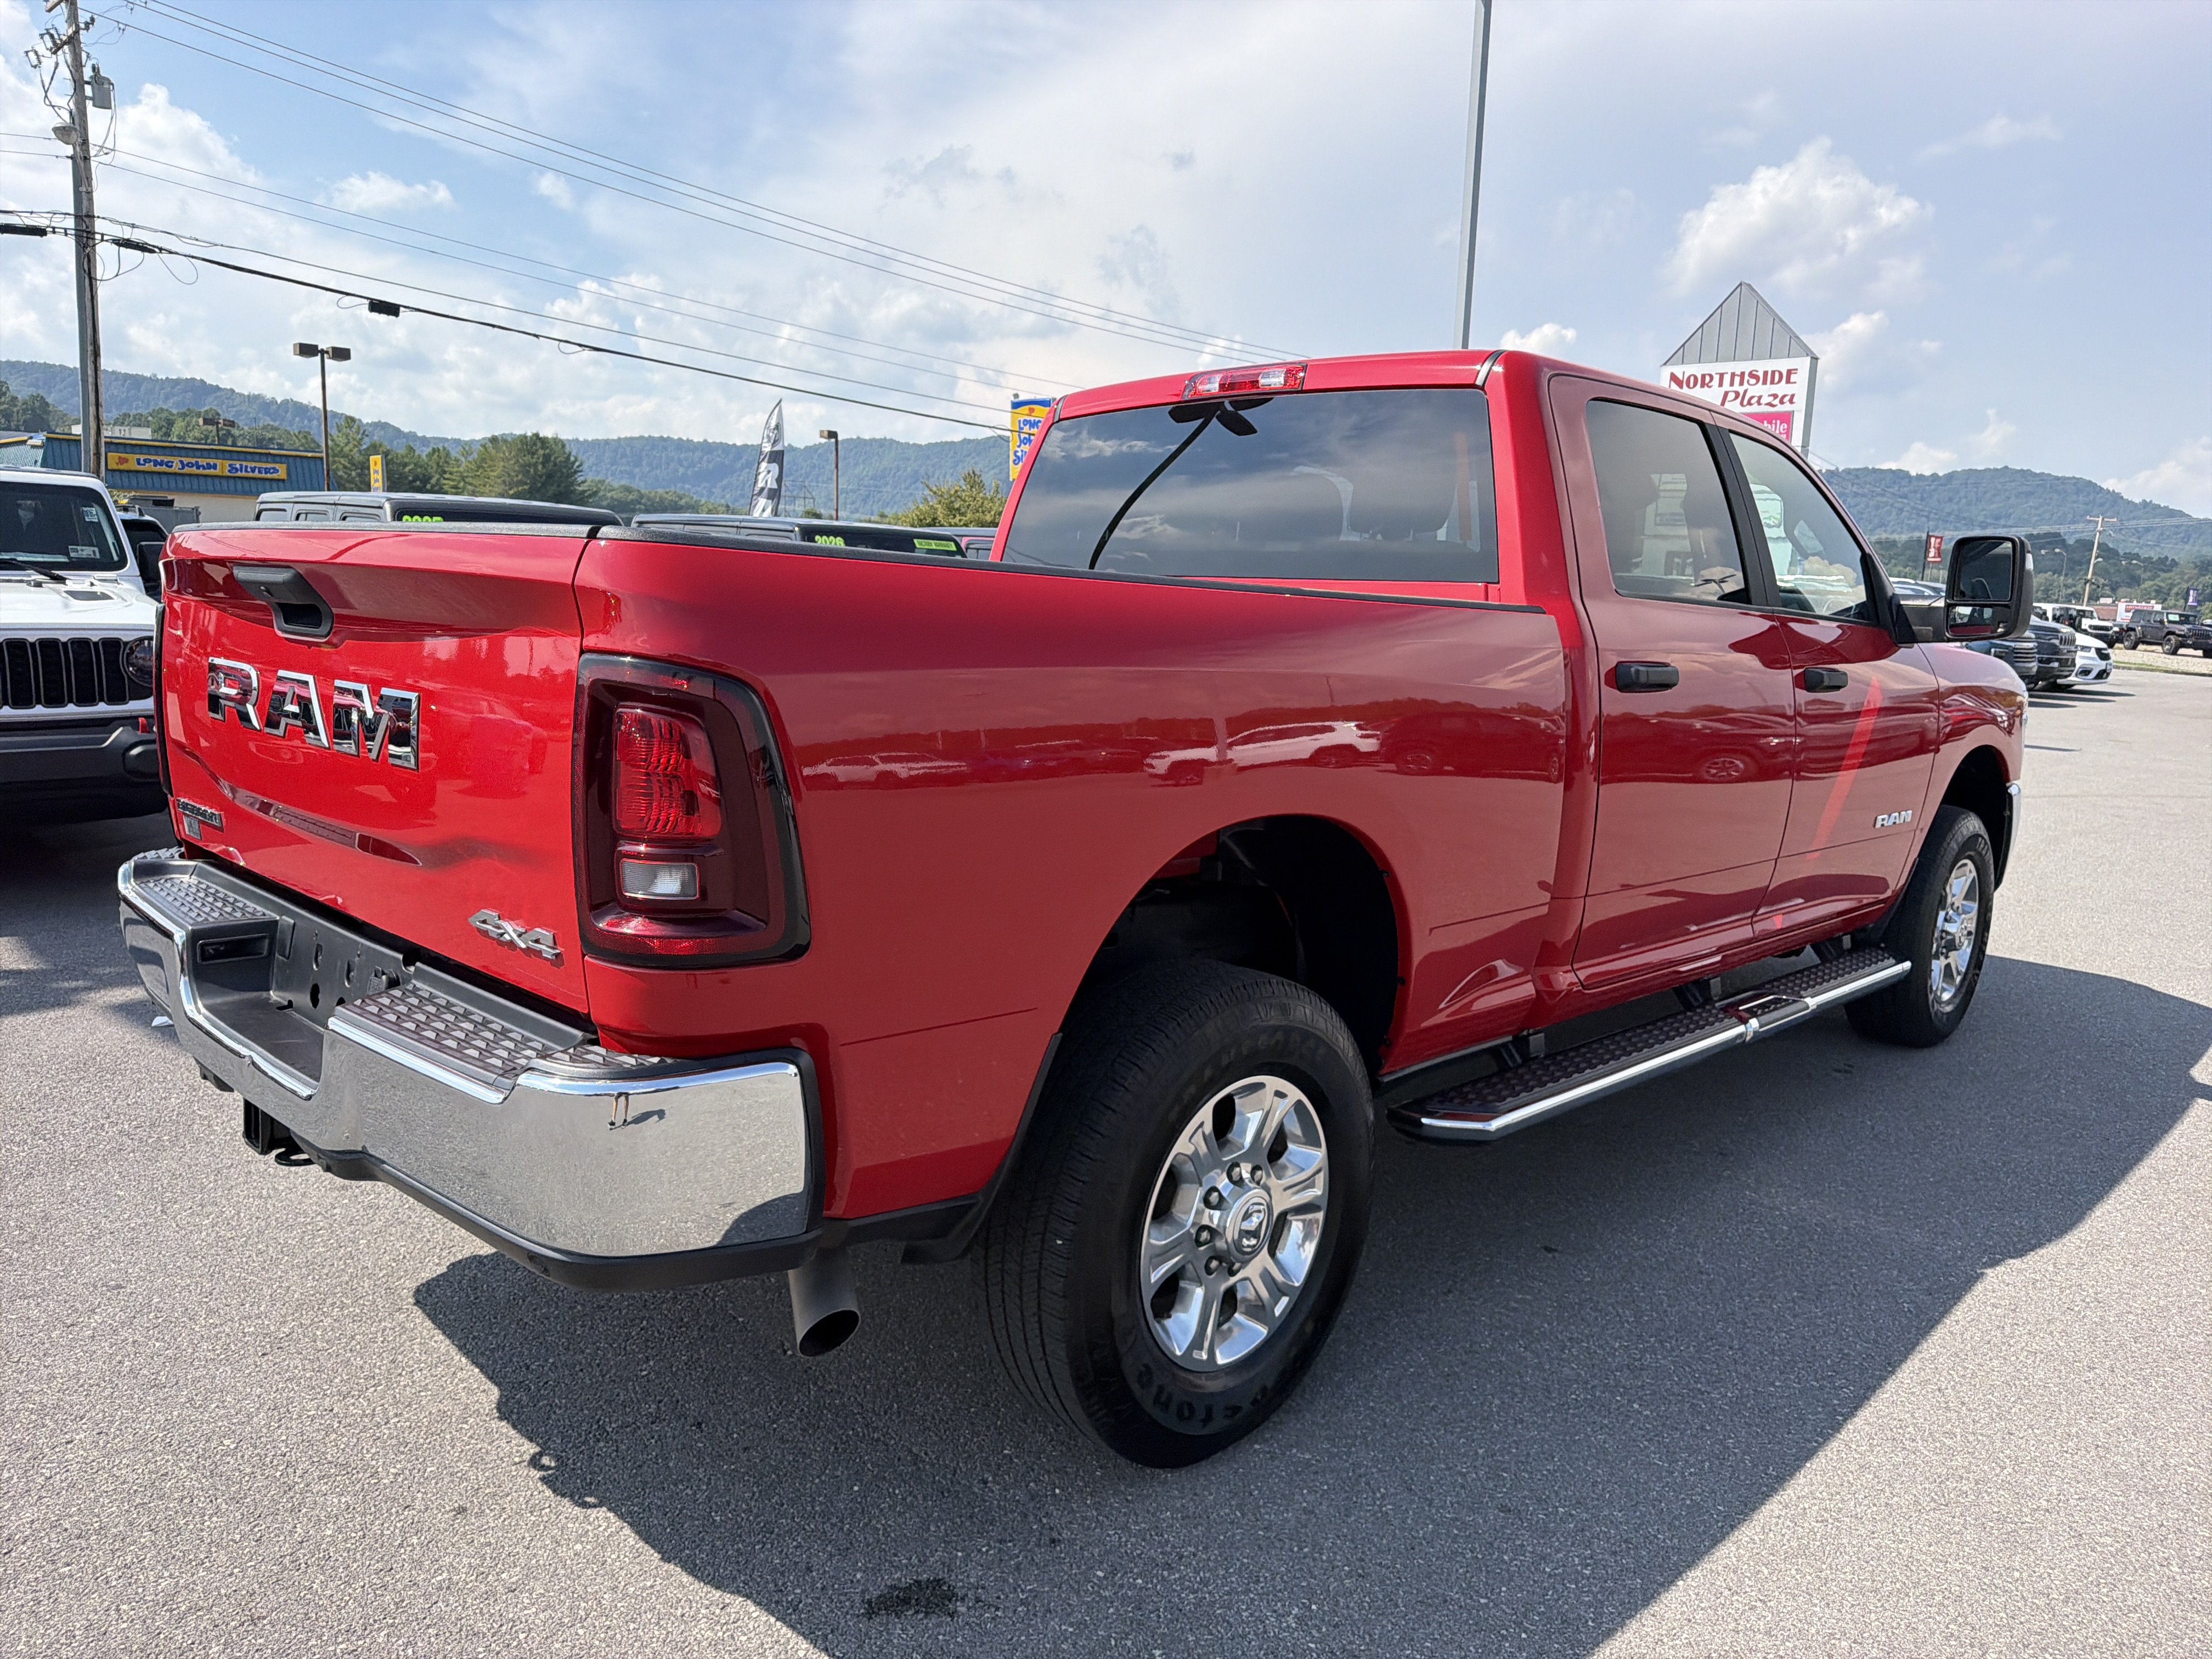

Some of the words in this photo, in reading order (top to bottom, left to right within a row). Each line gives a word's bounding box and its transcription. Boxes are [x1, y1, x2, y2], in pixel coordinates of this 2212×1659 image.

[1669, 368, 1798, 390] NORTHSIDE
[1720, 388, 1796, 408] Plaza
[136, 458, 174, 468] LONG
[207, 656, 421, 772] RAM
[1874, 810, 1912, 829] RAM
